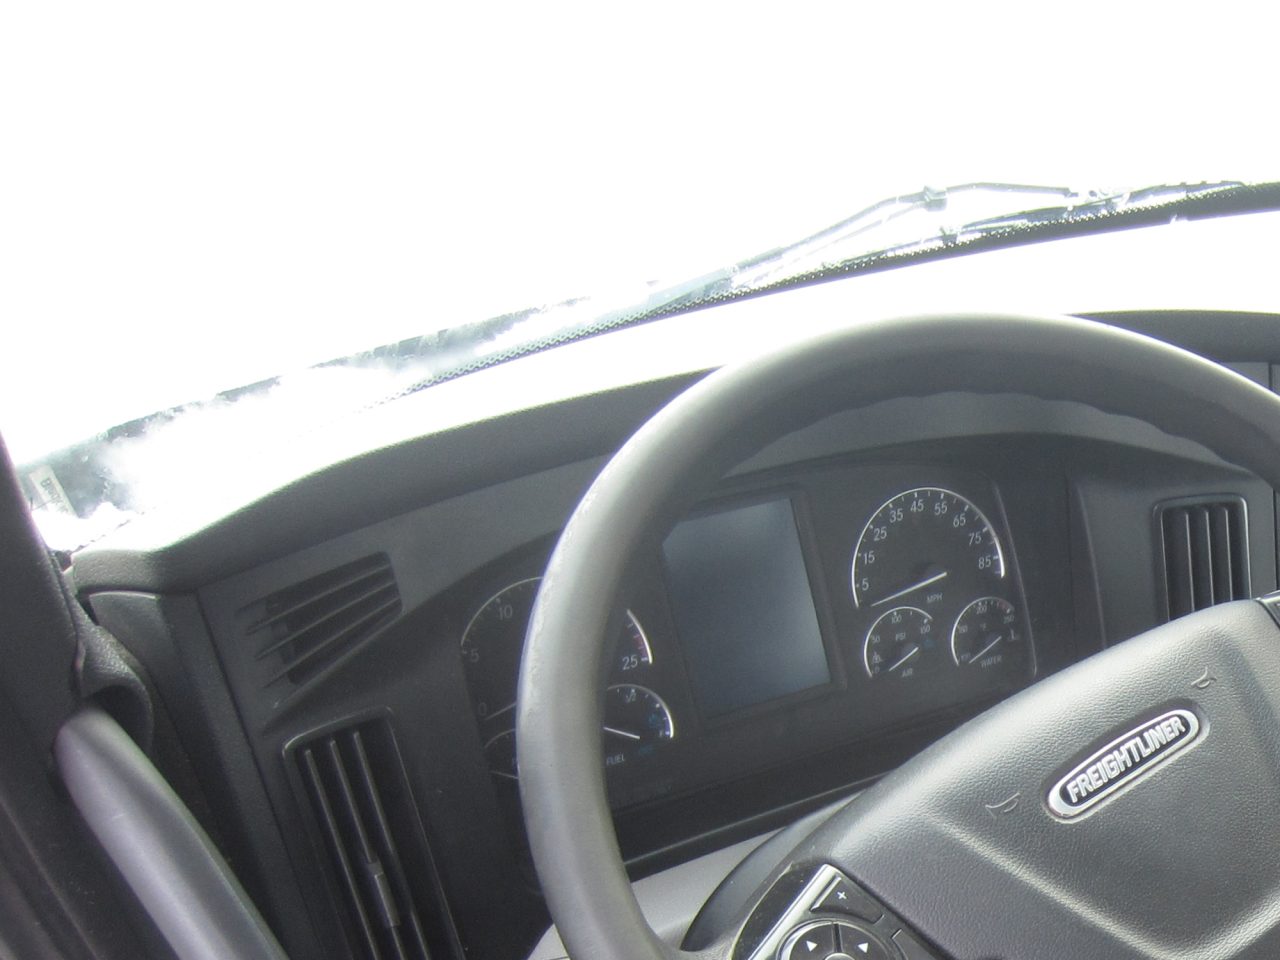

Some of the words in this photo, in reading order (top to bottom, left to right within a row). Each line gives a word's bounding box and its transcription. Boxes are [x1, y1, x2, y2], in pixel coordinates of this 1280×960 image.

[910, 499, 924, 512] 45
[934, 501, 948, 516] 55
[889, 508, 903, 523] 35
[953, 513, 966, 528] 65
[873, 526, 887, 541] 25
[968, 531, 982, 547] 75
[863, 551, 875, 565] 15
[978, 555, 991, 570] 85
[861, 578, 869, 591] 5
[499, 604, 512, 620] 10
[891, 614, 902, 624] 100
[470, 648, 480, 663] 5
[622, 655, 638, 670] 25
[478, 702, 487, 716] 0
[606, 753, 625, 766] FUEL
[1067, 717, 1186, 804] FREIGHTLINER
